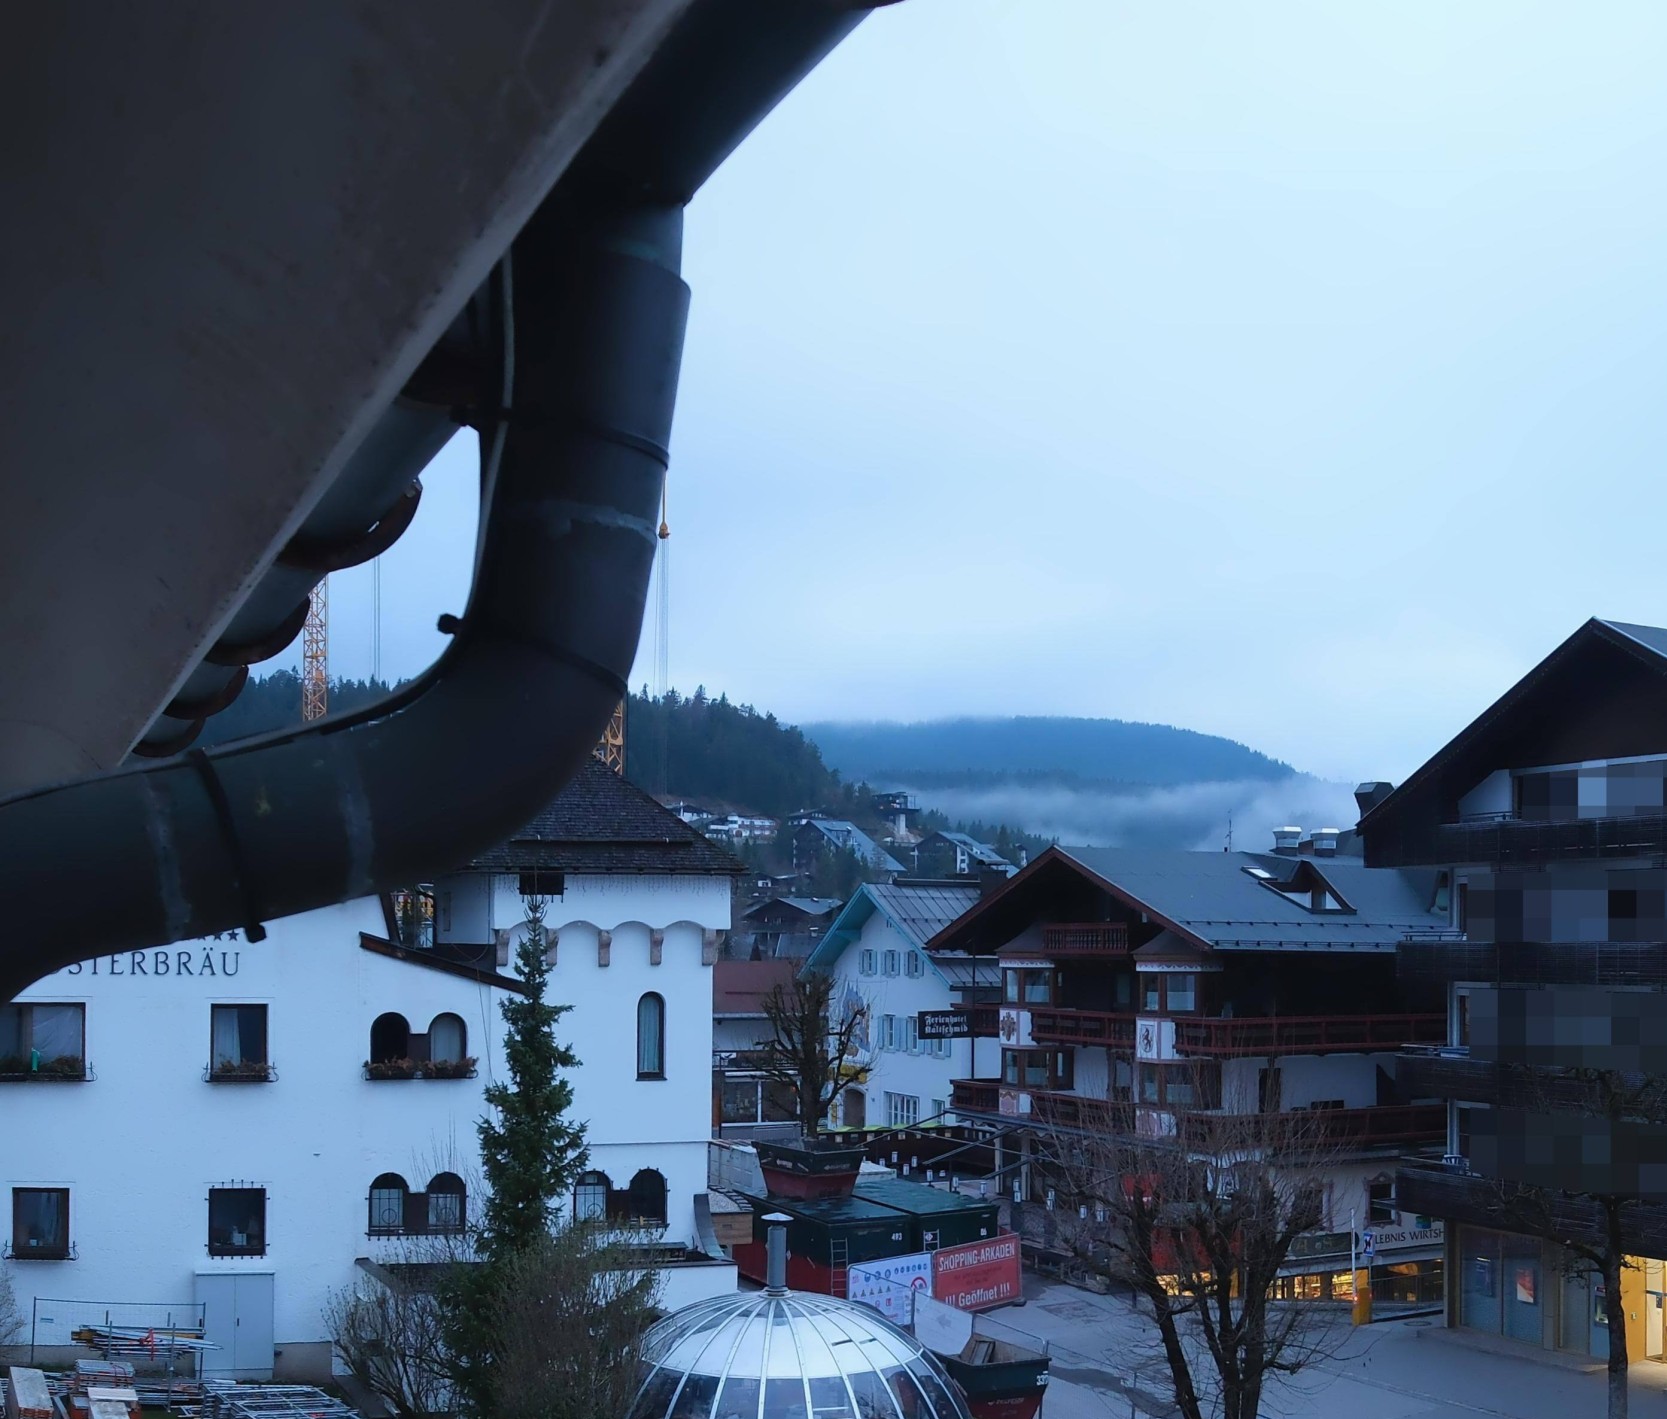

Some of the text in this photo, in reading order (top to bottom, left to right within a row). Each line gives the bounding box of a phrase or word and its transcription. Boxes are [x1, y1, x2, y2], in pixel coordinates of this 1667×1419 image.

[1375, 1232, 1406, 1245] LEBNIS
[938, 1242, 1015, 1272] SHOPPING-ARKADEN
[958, 1284, 998, 1307] Geöffnet
